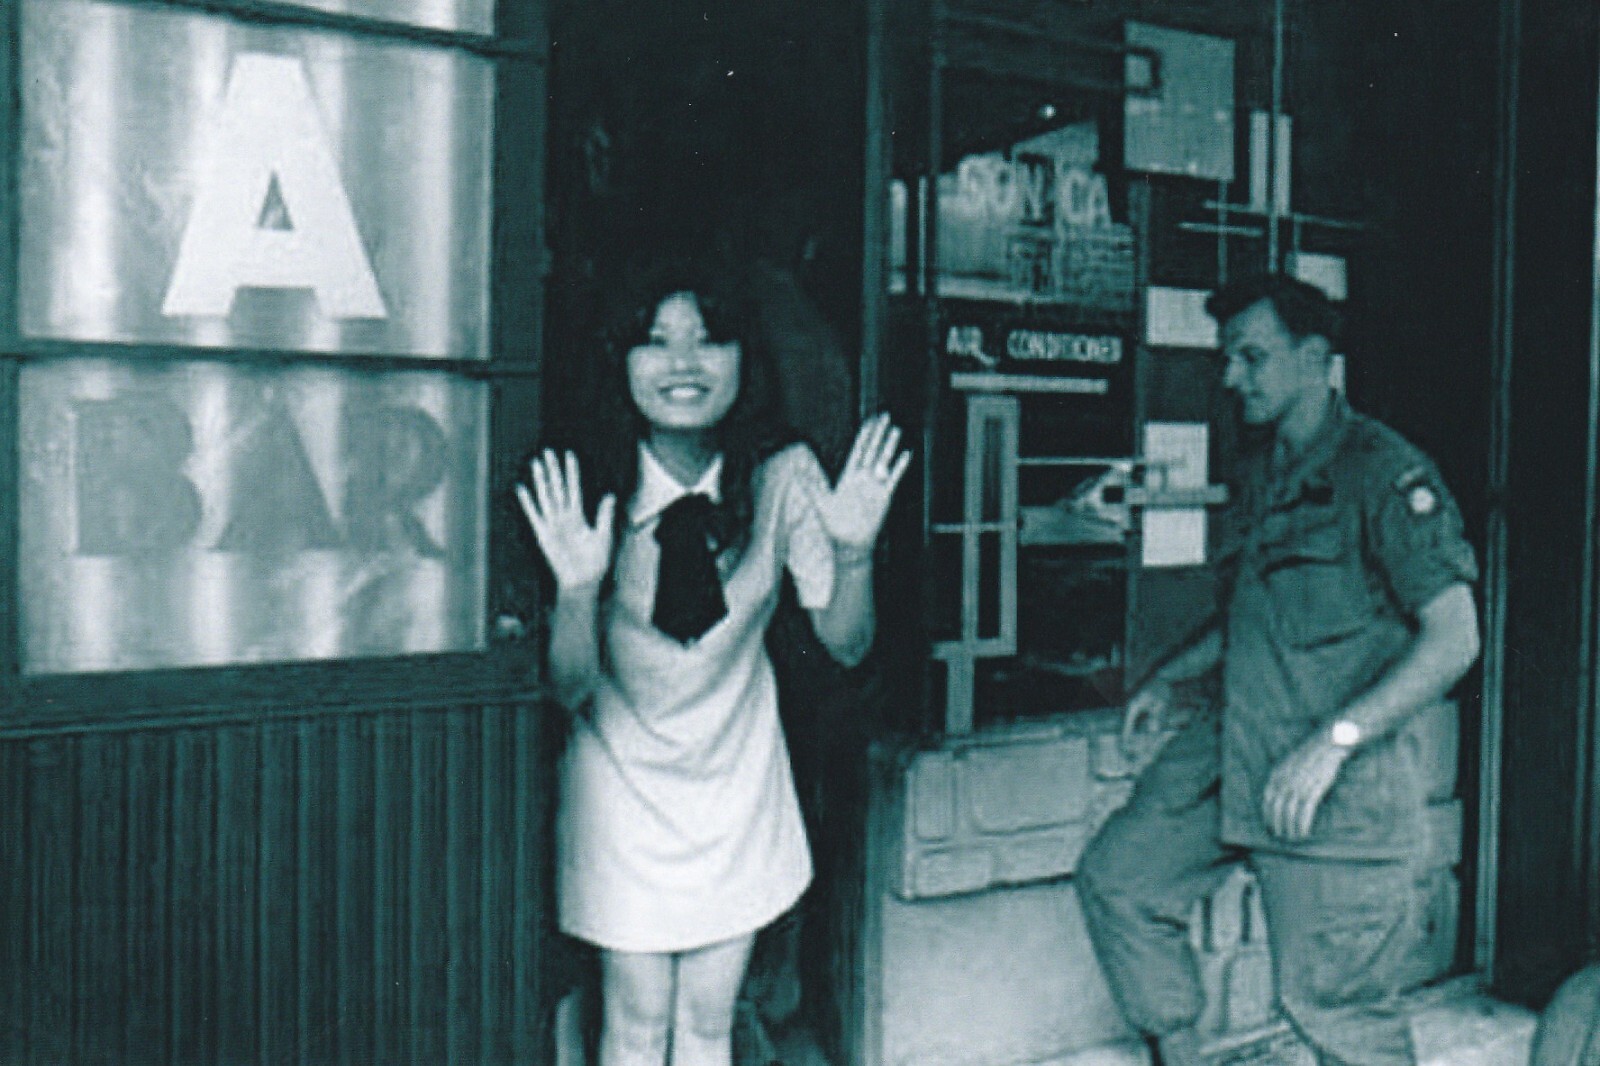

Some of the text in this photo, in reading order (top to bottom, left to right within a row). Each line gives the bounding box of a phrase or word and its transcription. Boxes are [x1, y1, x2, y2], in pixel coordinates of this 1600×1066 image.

[161, 53, 388, 318] A
[946, 326, 995, 366] AIR
[77, 401, 447, 557] BAR
